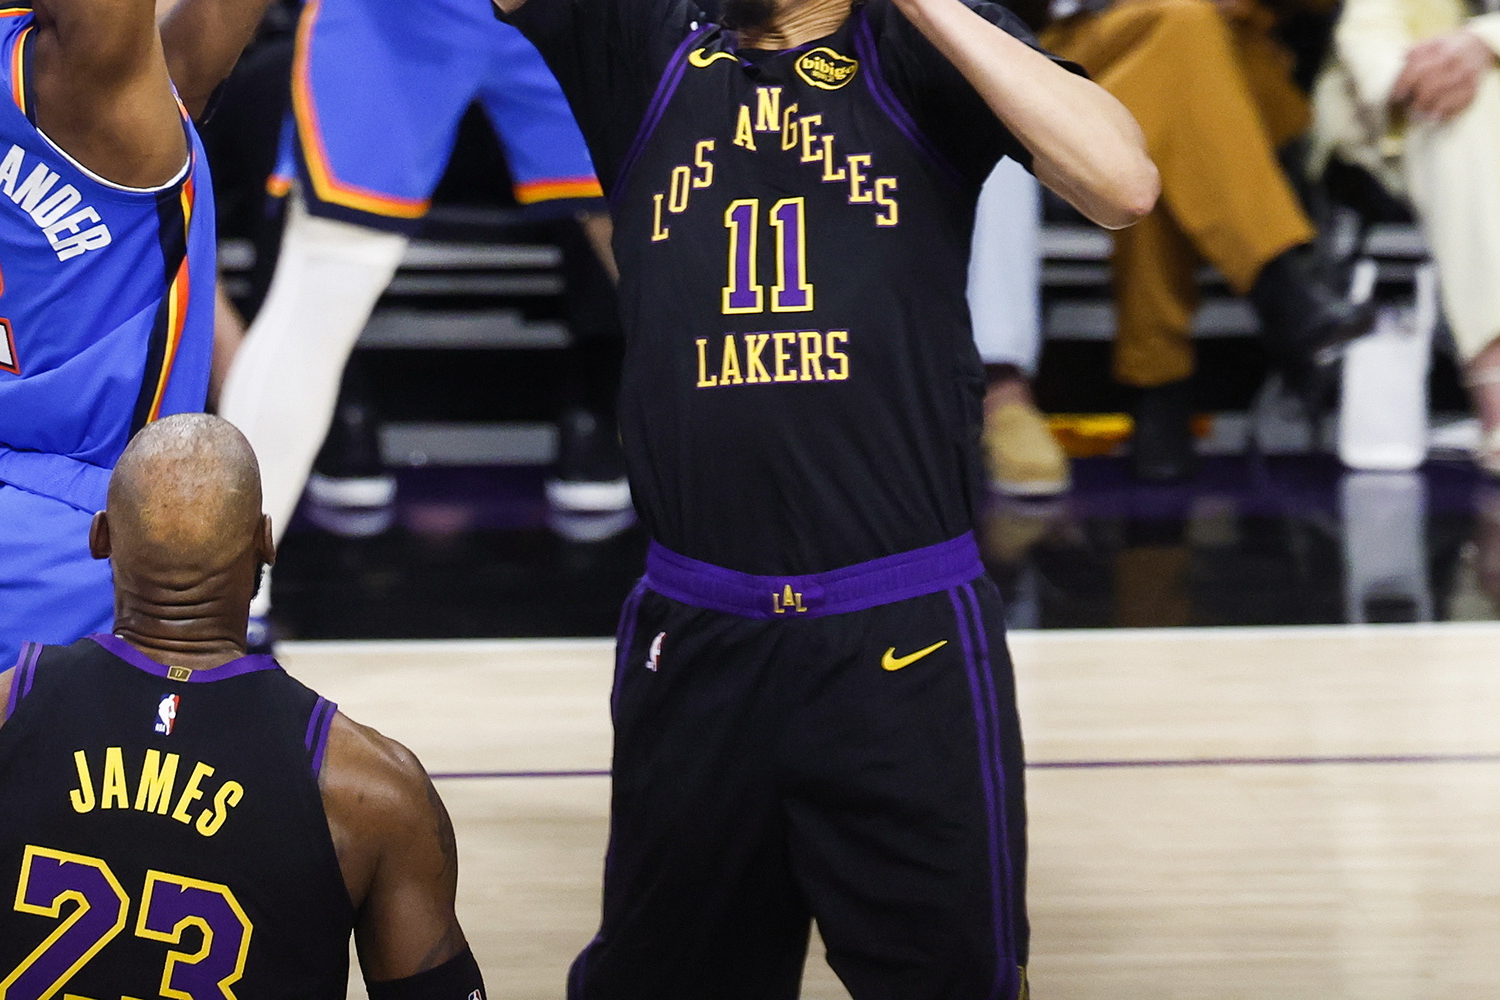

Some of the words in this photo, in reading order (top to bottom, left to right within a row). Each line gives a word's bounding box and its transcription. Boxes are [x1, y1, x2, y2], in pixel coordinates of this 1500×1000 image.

[651, 139, 715, 242] LOS
[733, 86, 899, 227] ANGELES
[722, 196, 814, 315] 11
[696, 330, 850, 389] LAKERS
[68, 746, 244, 837] JAMES
